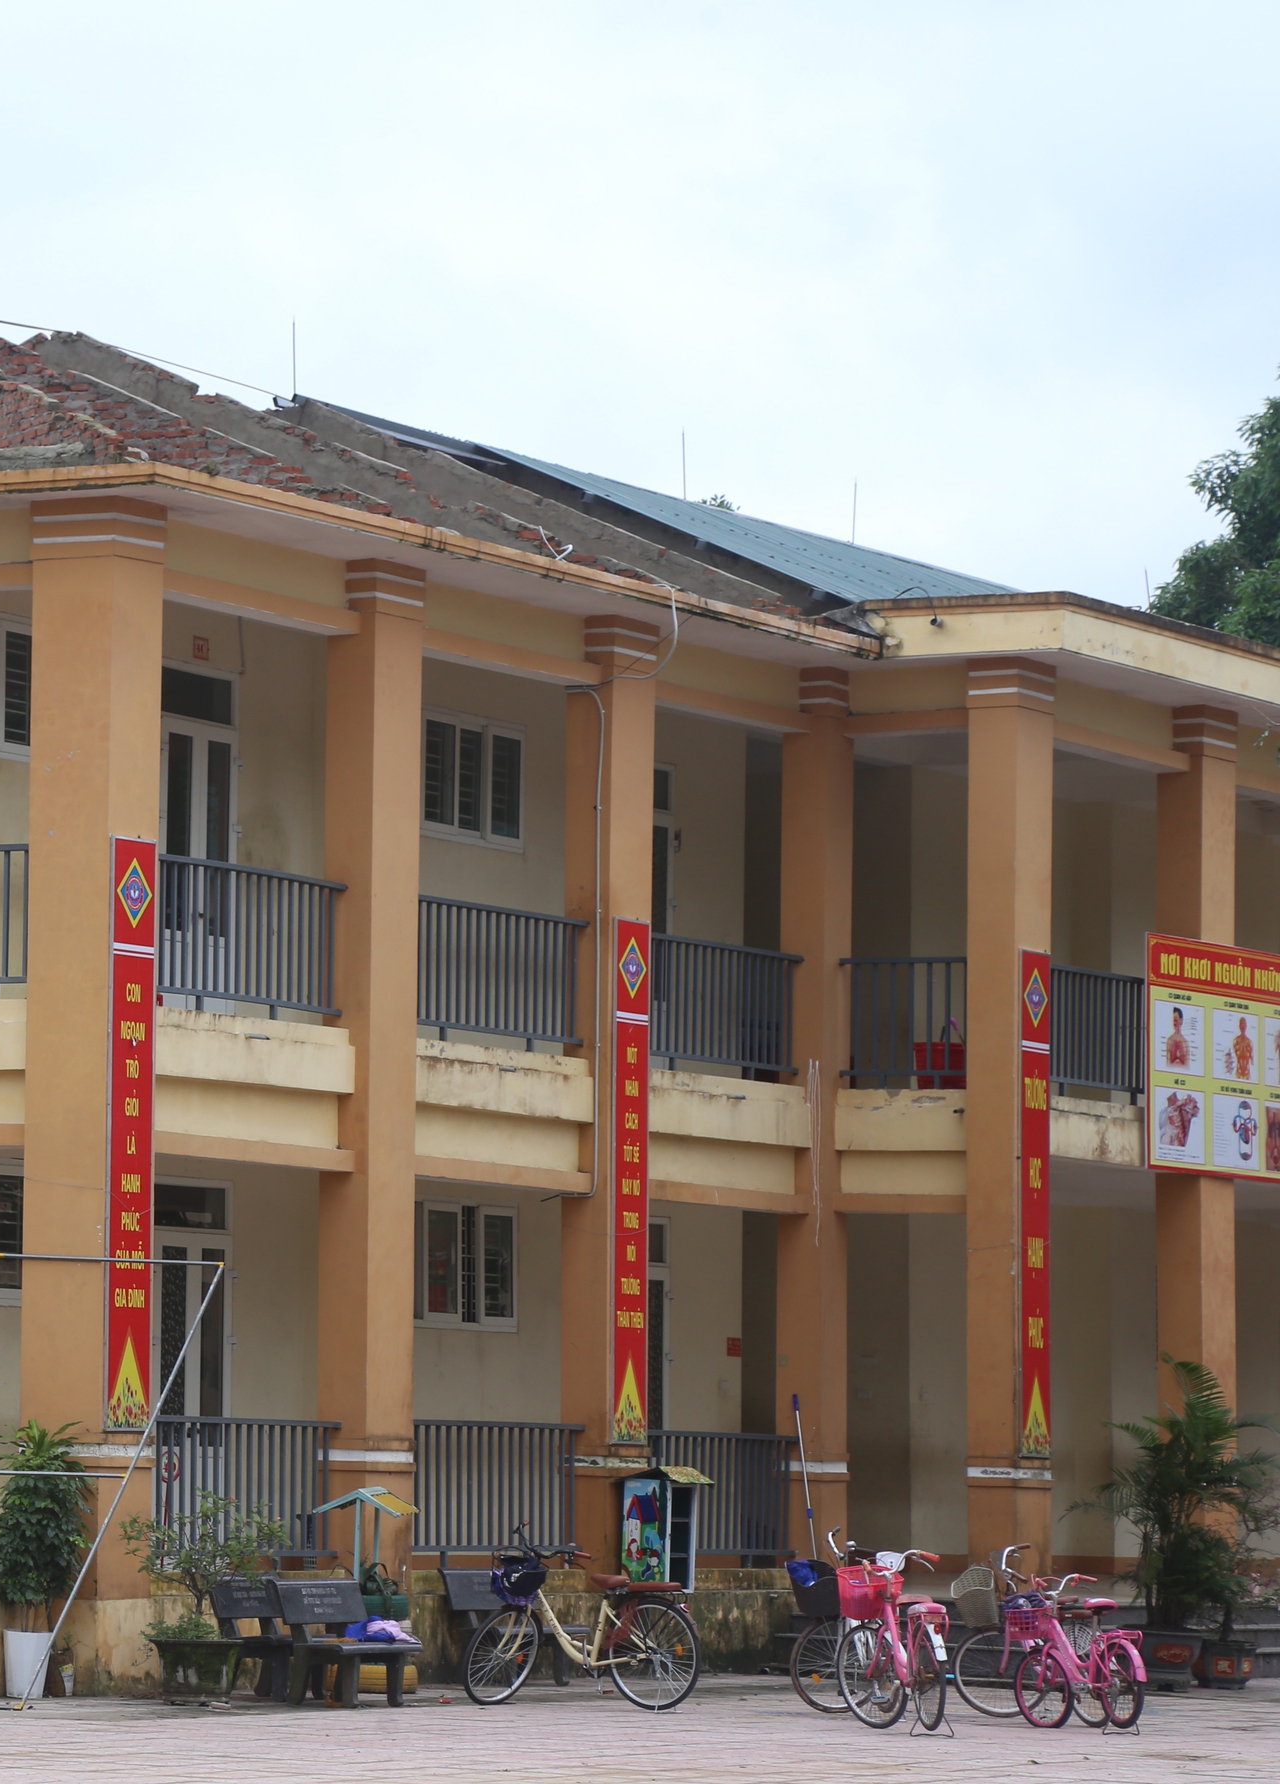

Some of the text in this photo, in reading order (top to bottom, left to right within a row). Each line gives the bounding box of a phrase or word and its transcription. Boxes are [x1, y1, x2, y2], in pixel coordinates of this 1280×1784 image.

[1160, 953, 1180, 976] NƠI
[1184, 957, 1211, 981] KHƠI
[1215, 958, 1251, 987] NGUỒN
[126, 983, 141, 1003] CON
[120, 1021, 145, 1041] NGOAN
[125, 1055, 139, 1079] TRÒ
[626, 1043, 638, 1069] MỘT
[624, 1076, 639, 1097] NHÂN
[1025, 1069, 1047, 1110] TRƯỜNG
[125, 1089, 139, 1117] GIỎI
[625, 1108, 639, 1130] CÁCH
[126, 1131, 137, 1155] LÀ
[623, 1138, 640, 1163] TỐT SẼ
[121, 1173, 141, 1199] HẠNH
[1030, 1157, 1042, 1199] HỌC
[121, 1207, 140, 1232] PHÚC
[623, 1211, 639, 1229] TRONG
[115, 1241, 145, 1270] CỦA MỖI
[626, 1241, 637, 1262] MÔI
[1027, 1236, 1044, 1279] HẠNH
[115, 1284, 145, 1308] GIA ĐÌNH
[621, 1273, 641, 1296] TRƯỜNG
[617, 1307, 644, 1333] THÂN THIỆN
[1028, 1308, 1044, 1349] PHÚC
